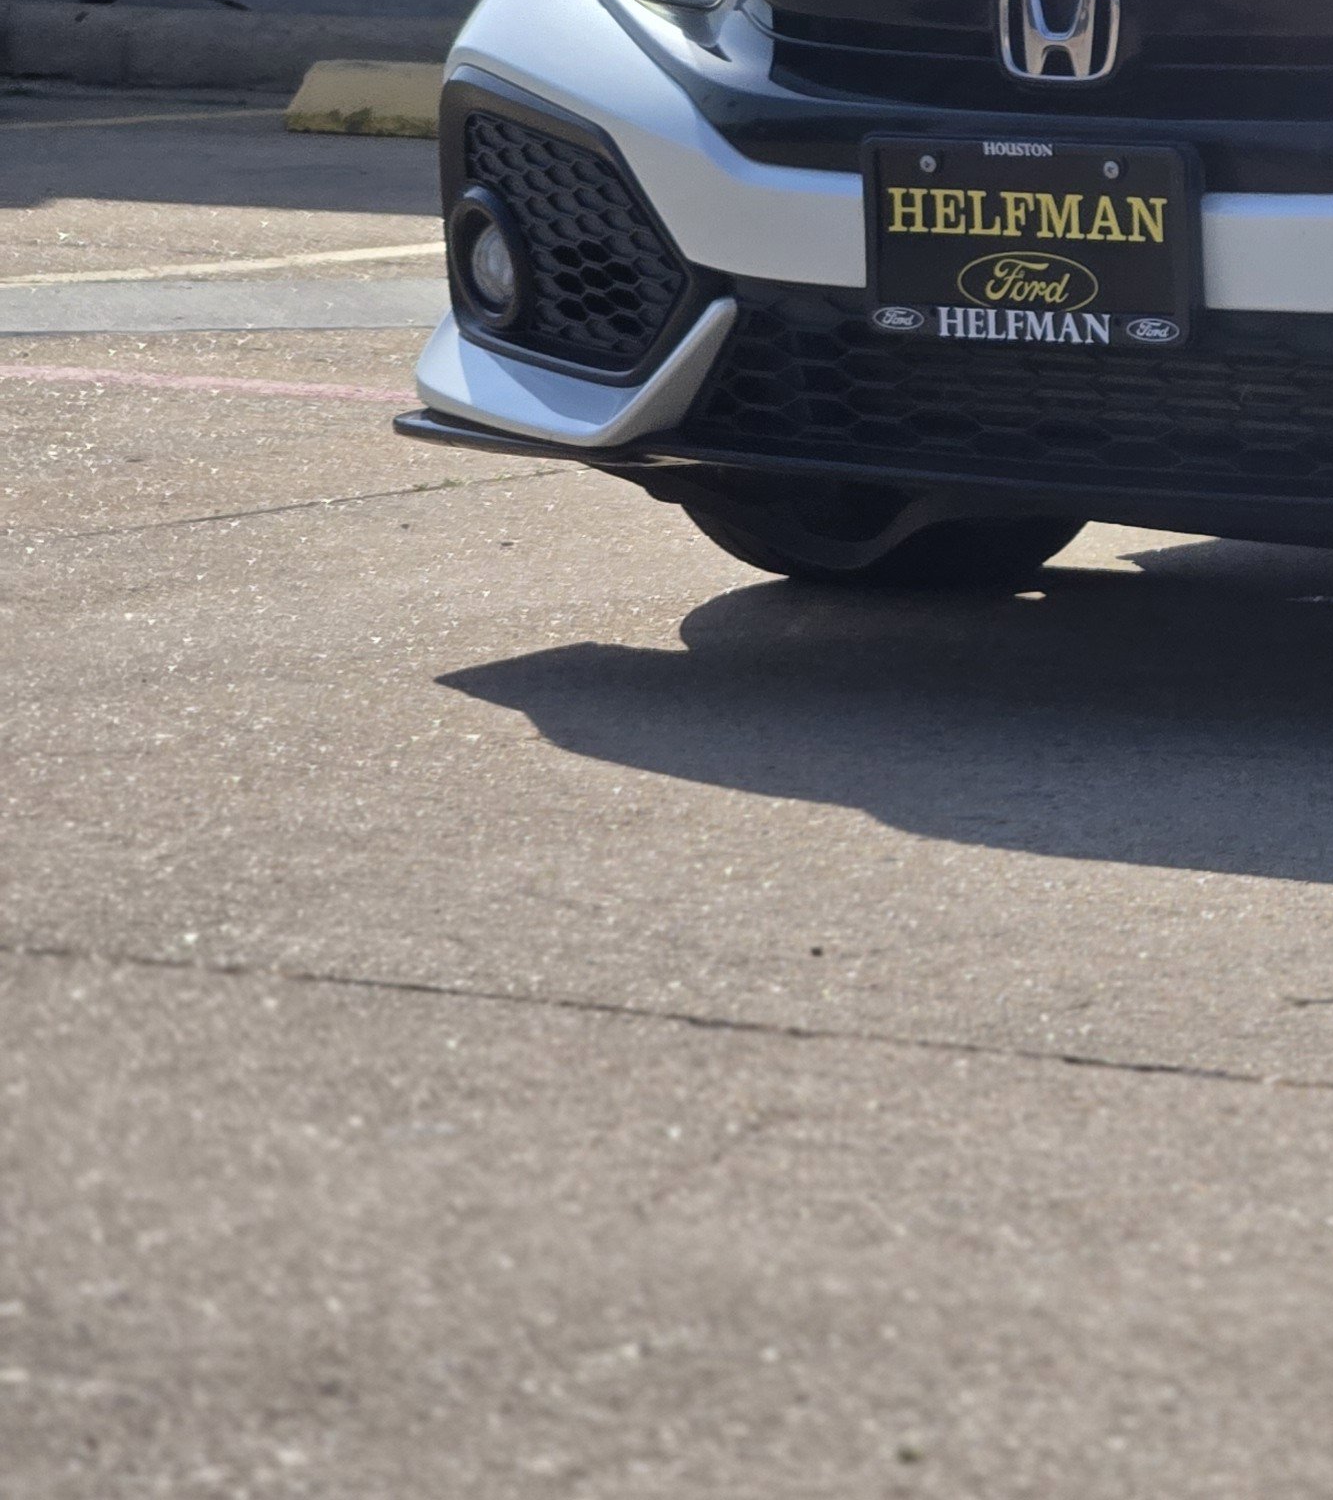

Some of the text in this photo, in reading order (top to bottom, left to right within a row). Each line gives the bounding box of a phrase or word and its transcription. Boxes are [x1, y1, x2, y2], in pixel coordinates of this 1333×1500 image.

[983, 141, 1053, 157] HOUSTON
[888, 187, 1168, 243] HELFMAN
[985, 258, 1070, 304] Ford
[881, 306, 1170, 345] Ford HELFMAN Ford
